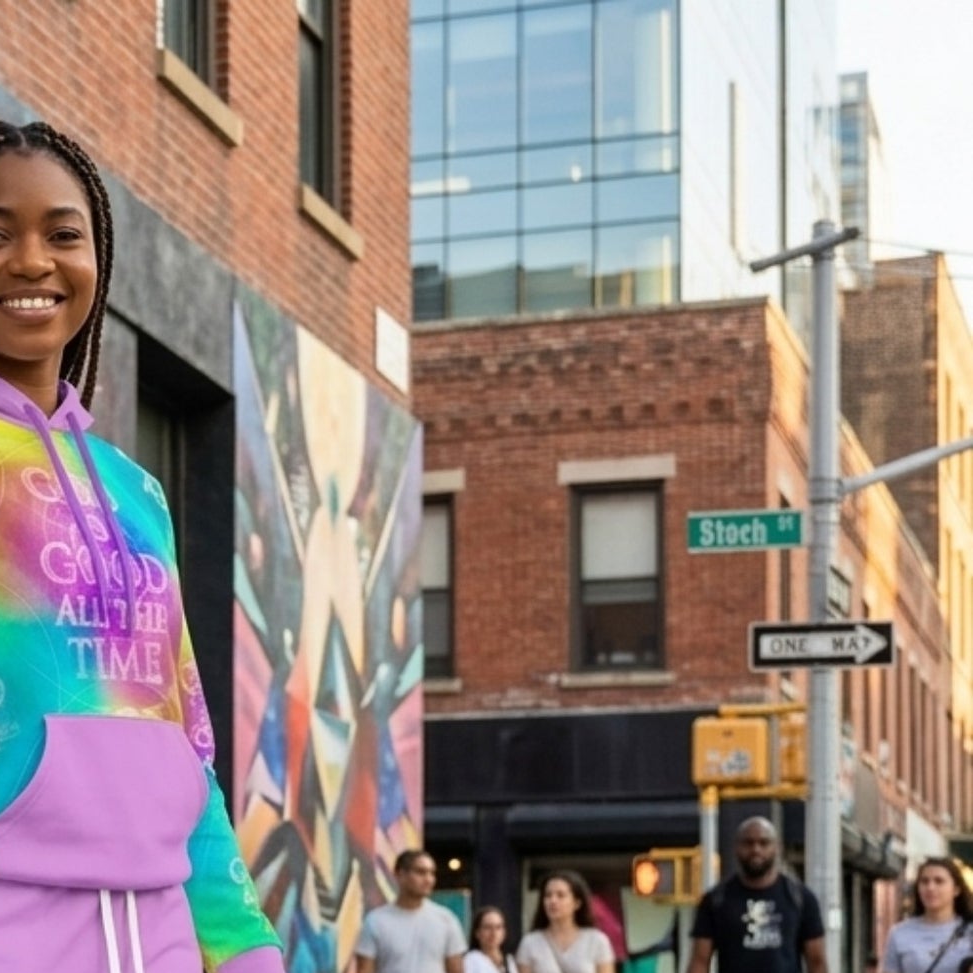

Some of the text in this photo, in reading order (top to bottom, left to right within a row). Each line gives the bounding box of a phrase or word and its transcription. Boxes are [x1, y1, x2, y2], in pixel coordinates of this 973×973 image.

[699, 517, 767, 546] Stoch
[67, 636, 164, 684] TIME
[770, 637, 807, 654] ONE
